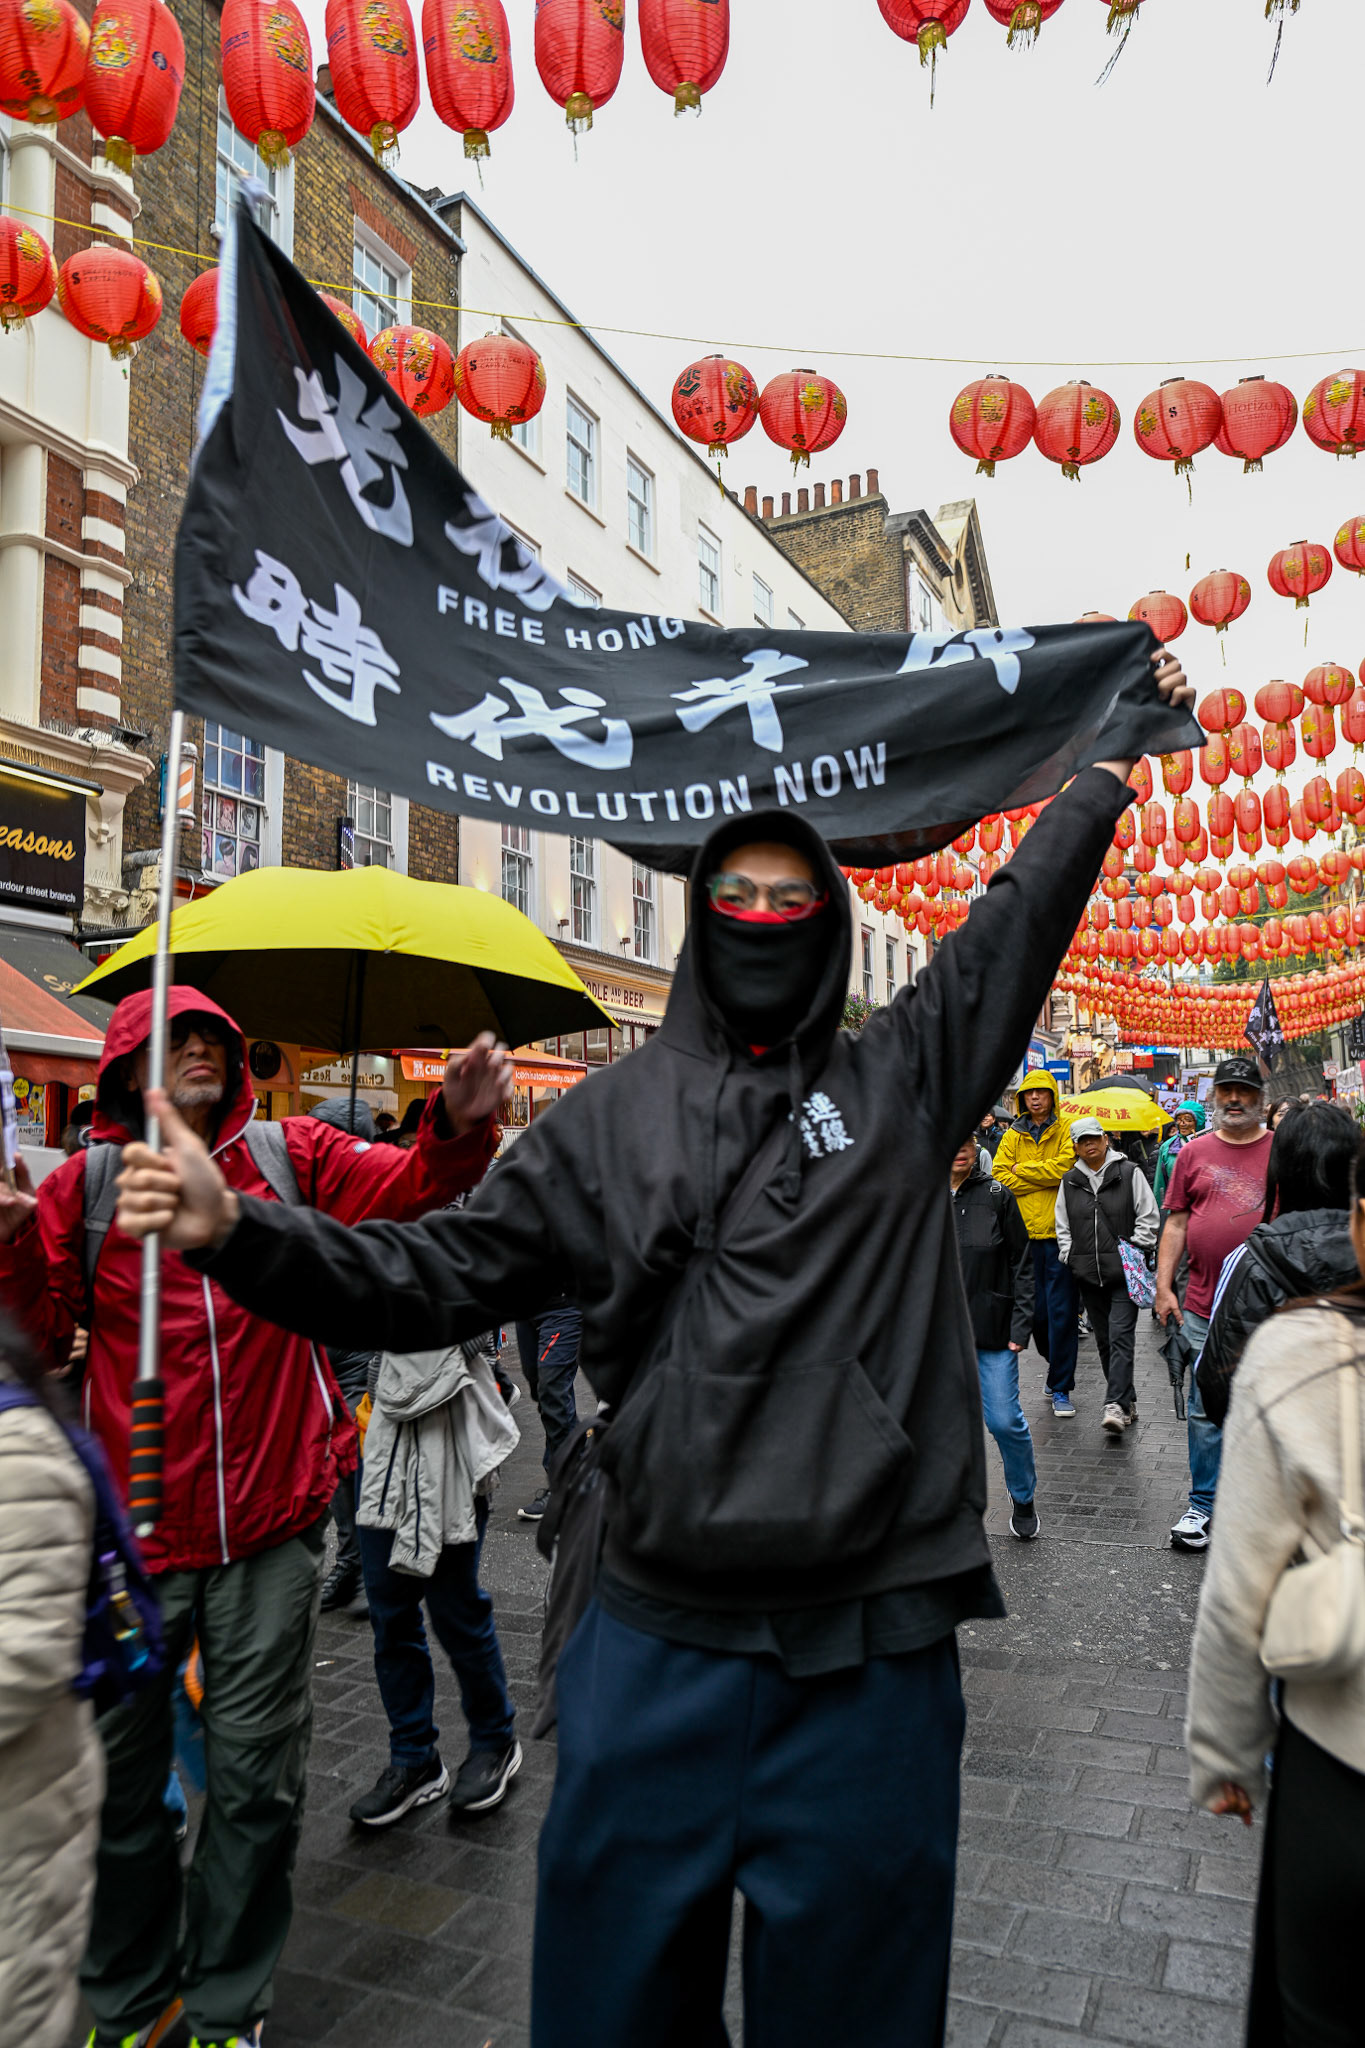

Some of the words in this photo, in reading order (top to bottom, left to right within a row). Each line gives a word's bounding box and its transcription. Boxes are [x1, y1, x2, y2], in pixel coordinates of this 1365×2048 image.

[1227, 400, 1288, 416] Horizons
[437, 583, 546, 646] FREE
[564, 614, 687, 653] HONG
[426, 759, 752, 823] REVOLUTION
[774, 741, 888, 806] NOW
[25, 885, 48, 898] street
[49, 889, 76, 903] branch
[623, 989, 645, 1009] BEER
